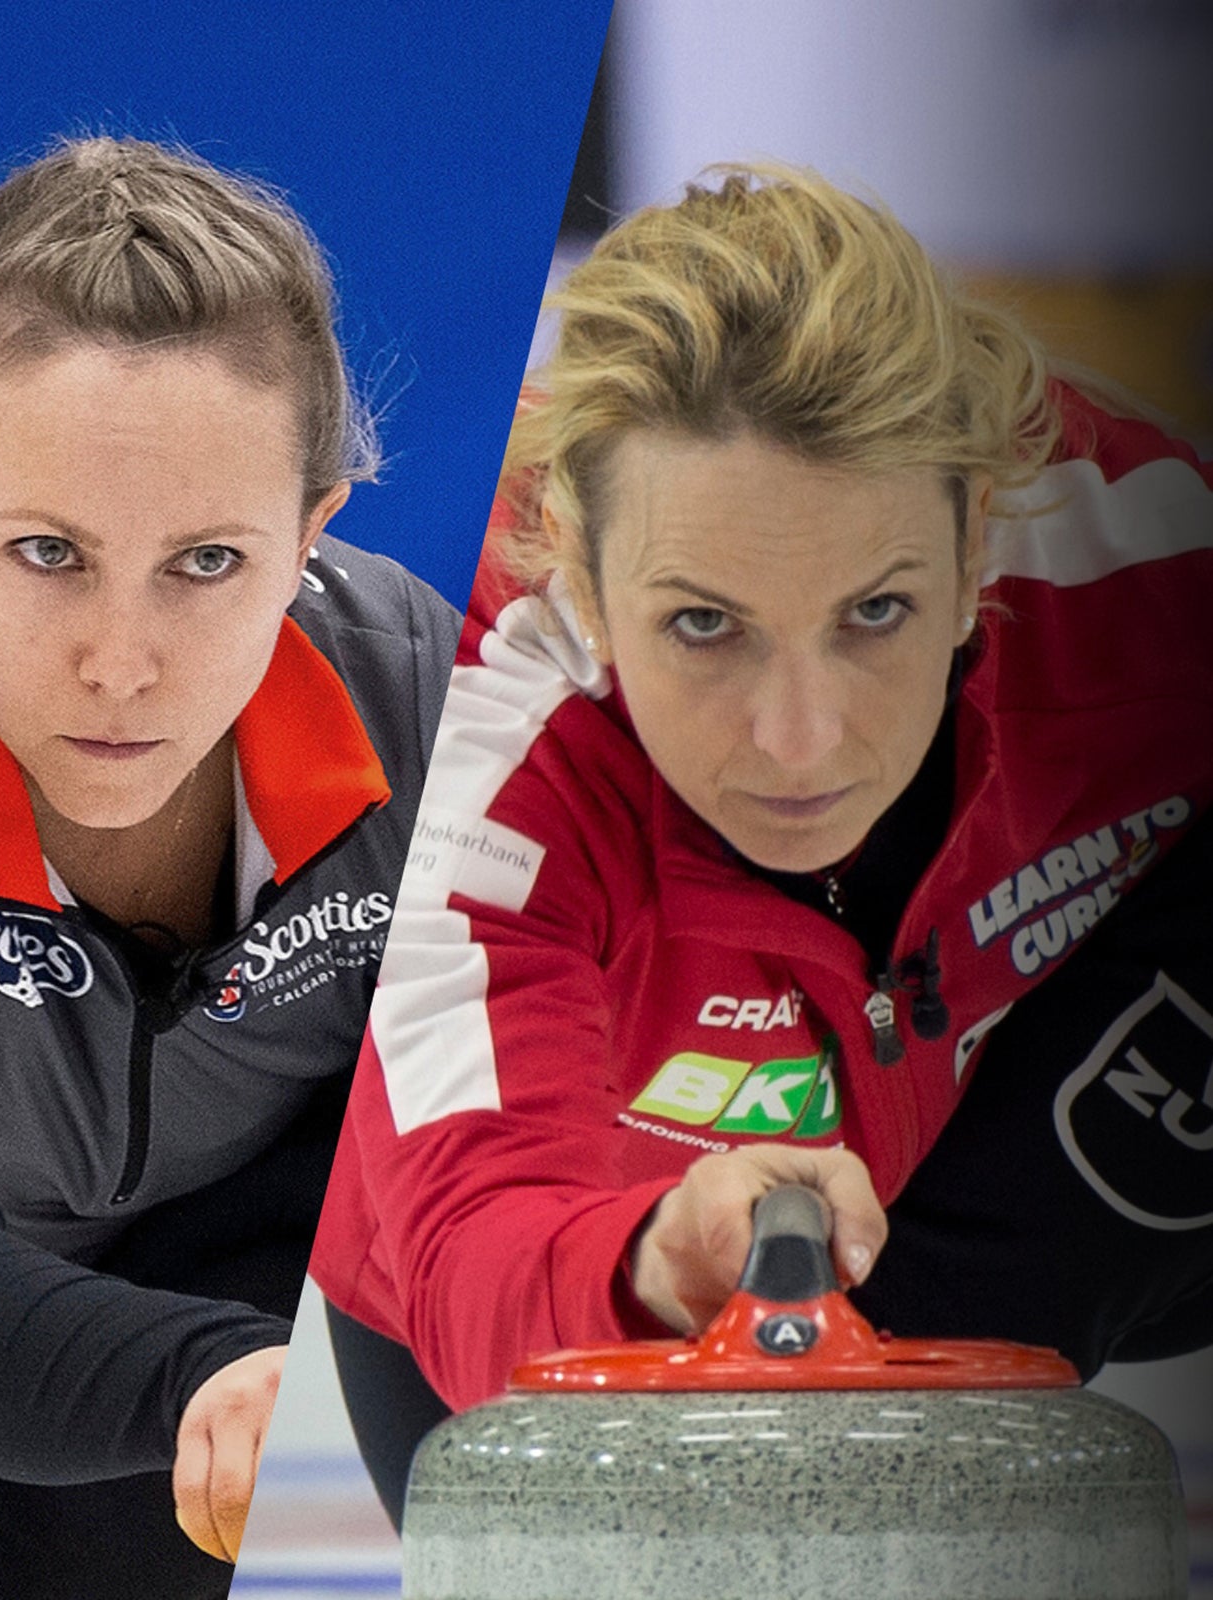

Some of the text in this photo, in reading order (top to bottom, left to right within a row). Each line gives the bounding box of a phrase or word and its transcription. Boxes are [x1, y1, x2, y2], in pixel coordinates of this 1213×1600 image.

[413, 819, 532, 873] hekarbank
[968, 795, 1190, 947] LEARN TO
[243, 892, 393, 982] Scotties
[1011, 881, 1121, 976] CURL
[617, 1112, 730, 1154] GROWING
[773, 1321, 803, 1345] A
